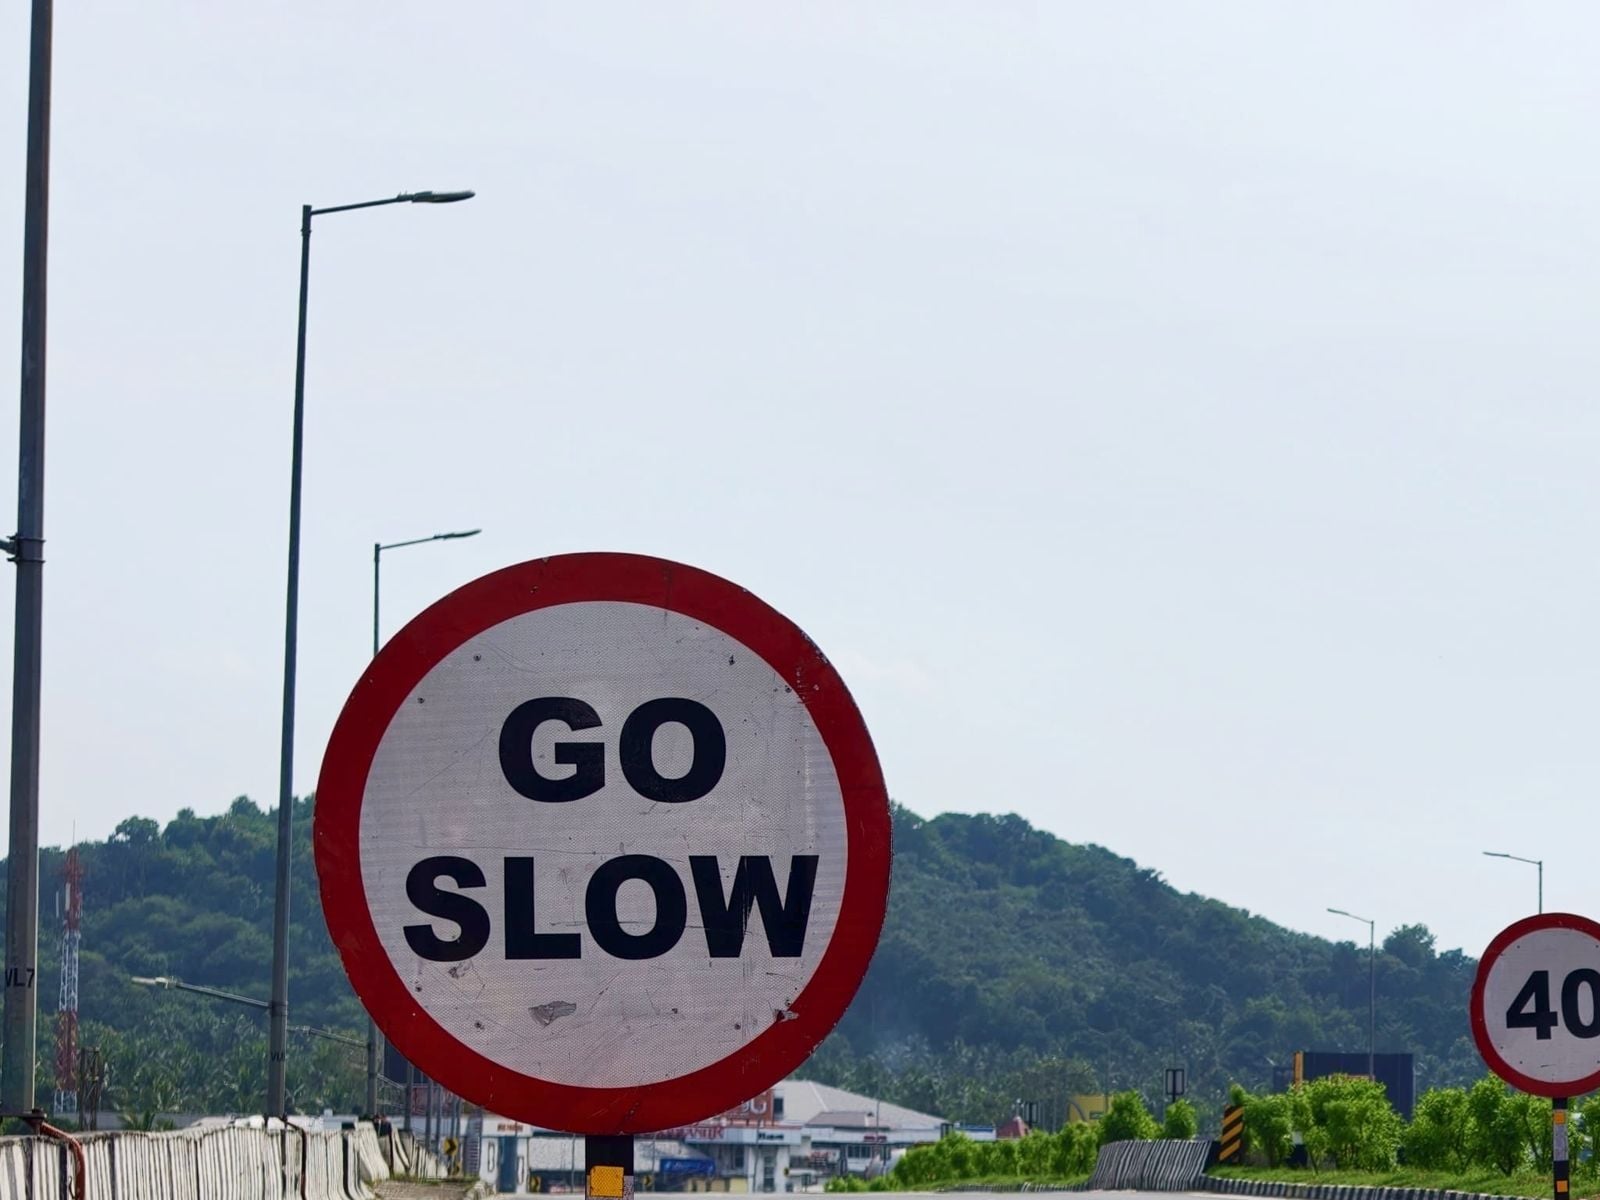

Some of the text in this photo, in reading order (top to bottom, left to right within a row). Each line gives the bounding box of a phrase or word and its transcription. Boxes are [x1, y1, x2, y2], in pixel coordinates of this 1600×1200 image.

[499, 697, 726, 803] GO
[402, 854, 819, 962] SLOW
[5, 968, 35, 988] VL7
